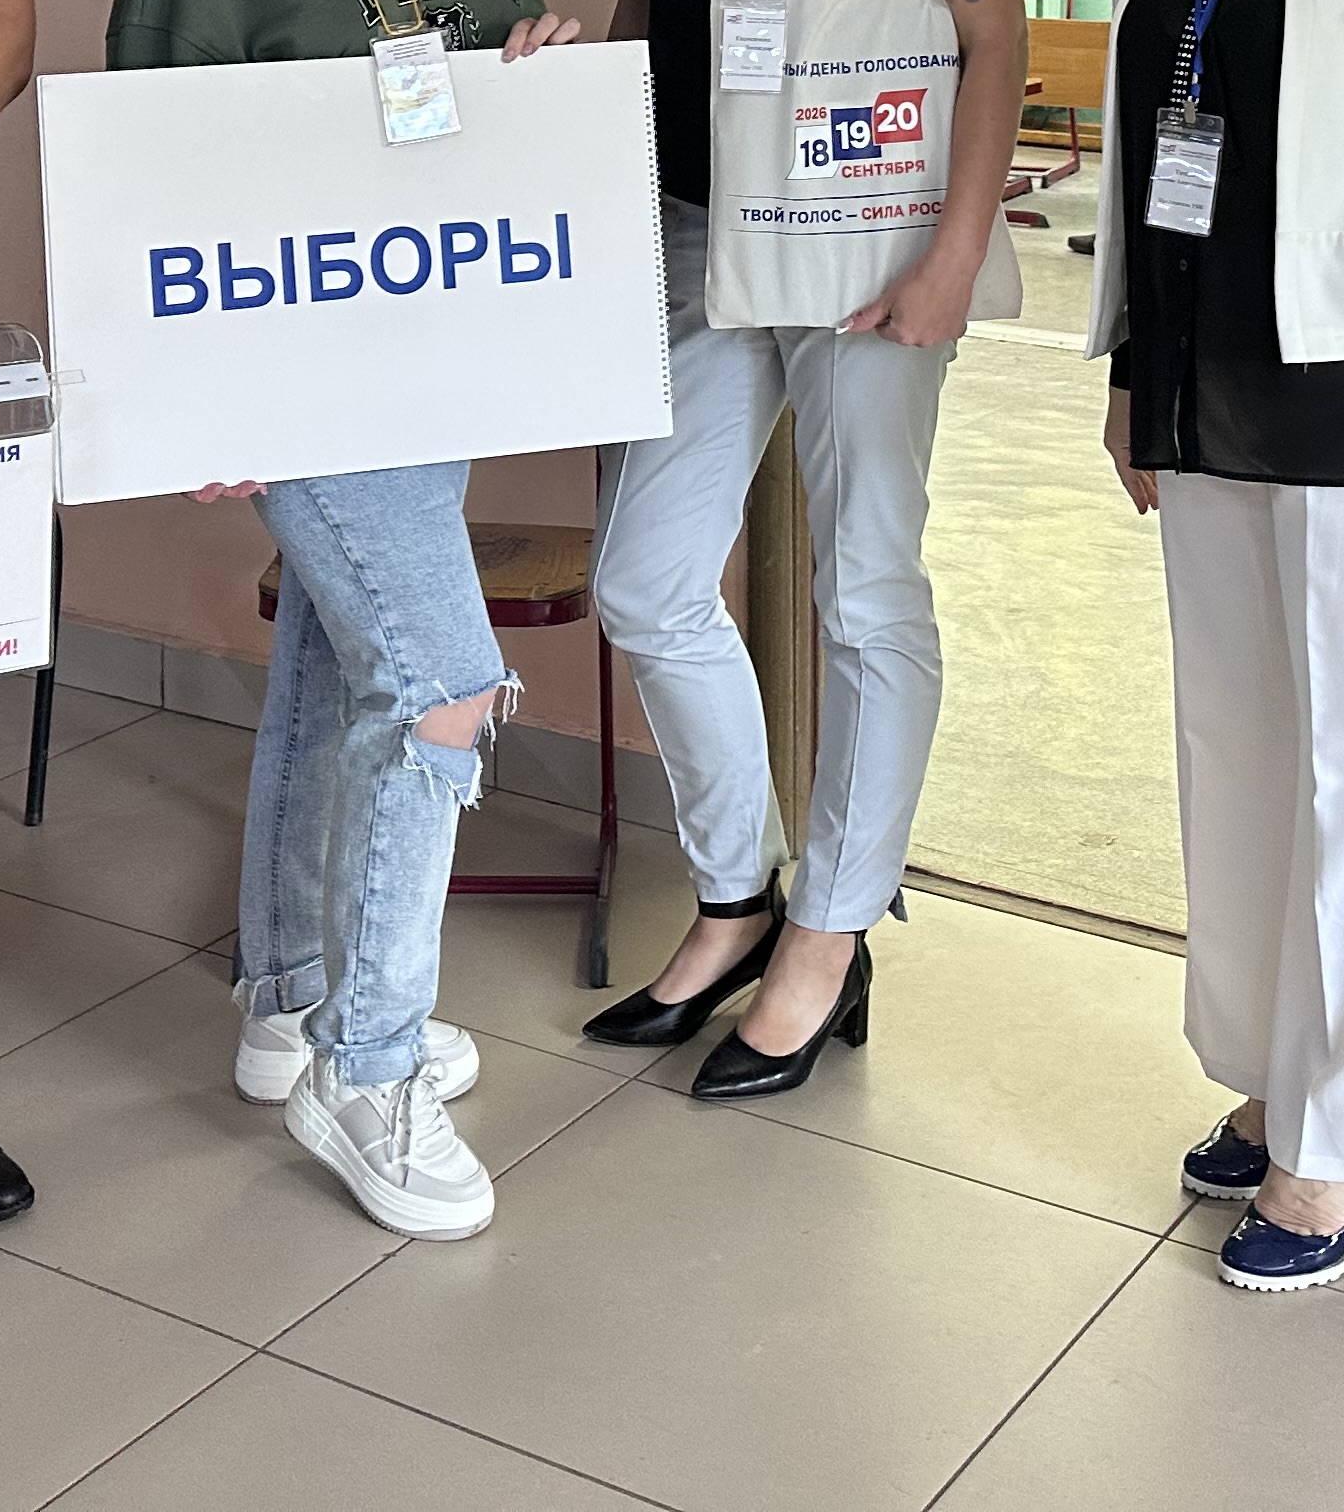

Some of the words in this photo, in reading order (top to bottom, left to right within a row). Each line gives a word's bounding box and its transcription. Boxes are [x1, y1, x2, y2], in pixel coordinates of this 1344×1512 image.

[810, 62, 851, 77] ДЕНЬ
[795, 107, 827, 120] 2026
[876, 101, 919, 133] 20
[836, 120, 871, 150] 19
[800, 139, 829, 167] 18
[841, 160, 925, 178] СЕНТЯБРЯ
[741, 207, 784, 222] ТВОЙ
[789, 209, 842, 224] ГОЛОС
[861, 205, 904, 220] СИЛА
[149, 213, 573, 318] ВЫБОРЫ
